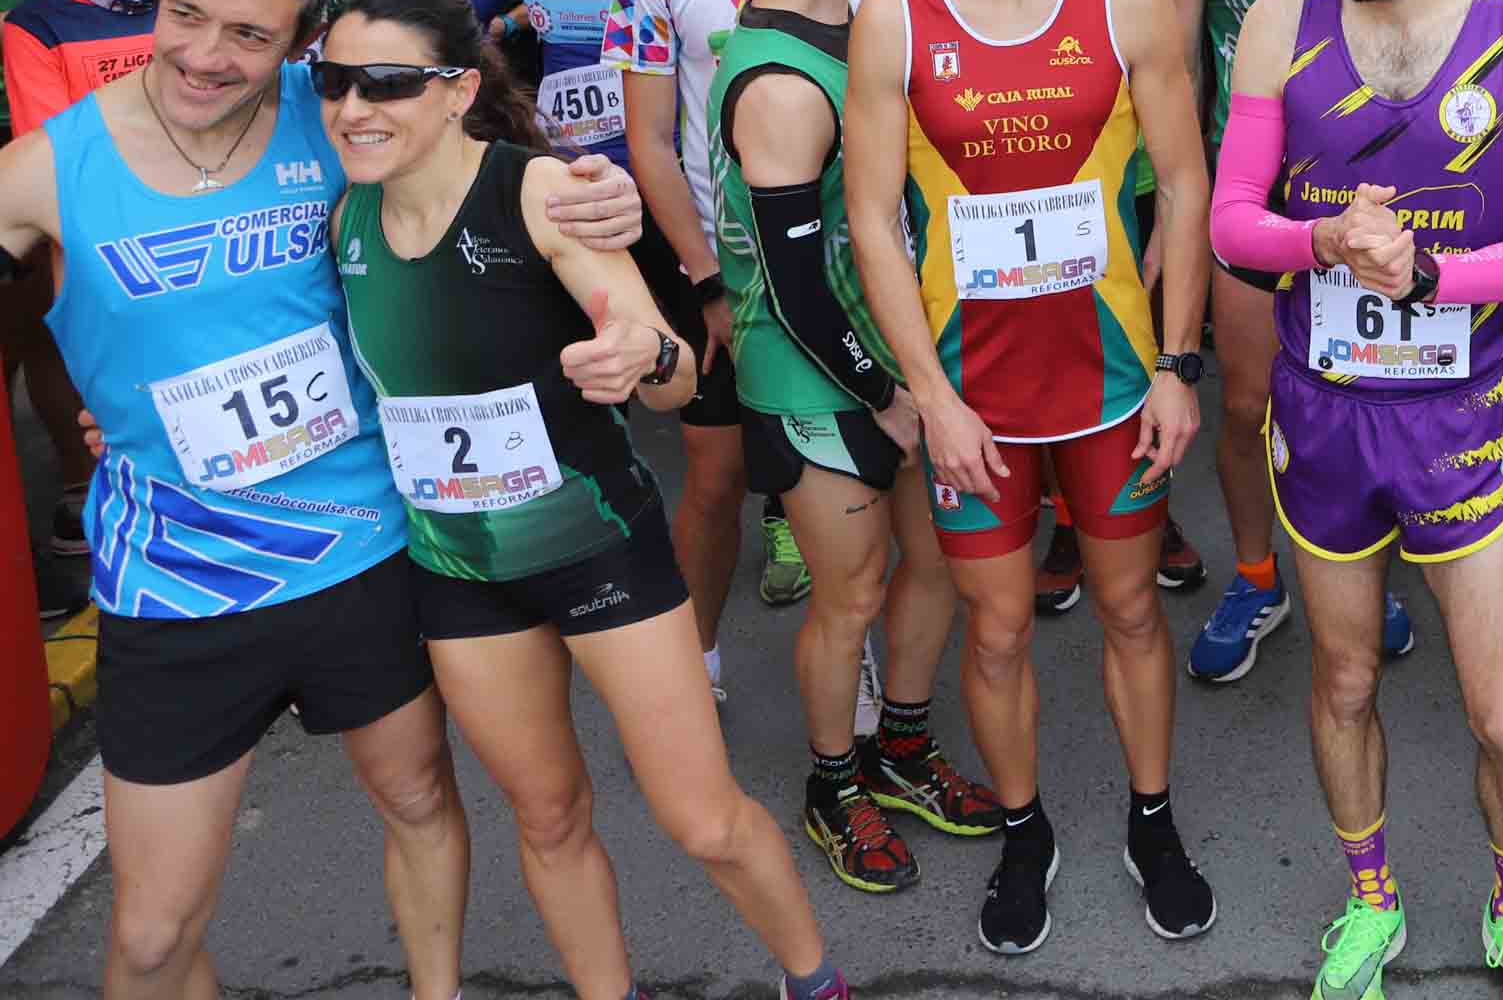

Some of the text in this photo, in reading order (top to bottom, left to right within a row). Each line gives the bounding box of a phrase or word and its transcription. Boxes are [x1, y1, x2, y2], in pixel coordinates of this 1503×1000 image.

[98, 58, 118, 73] 27
[552, 84, 605, 122] 450
[987, 86, 1075, 105] CAJA RURAL
[984, 114, 1049, 136] VINO
[962, 133, 1073, 159] DE TORO
[275, 159, 323, 186] HH
[221, 200, 329, 236] COMERCIAL
[982, 202, 1005, 219] LIGA
[1005, 198, 1038, 217] CROSS
[1037, 190, 1097, 214] CABRERIZOS
[1395, 208, 1466, 232] PRIM
[224, 220, 329, 278] ULSA
[1014, 218, 1038, 262] 1
[966, 256, 1097, 289] JOMISAGA
[1031, 275, 1097, 295] REFORMAS
[1356, 294, 1413, 342] 61
[192, 374, 223, 399] LIGA
[223, 360, 266, 387] CROSS
[263, 335, 331, 376] CABRERIZOS
[1384, 365, 1456, 376] REFORMAS
[222, 374, 300, 441] 15
[430, 404, 462, 425] CROSS
[200, 407, 348, 482] JOMISAGA
[444, 426, 480, 474] 2
